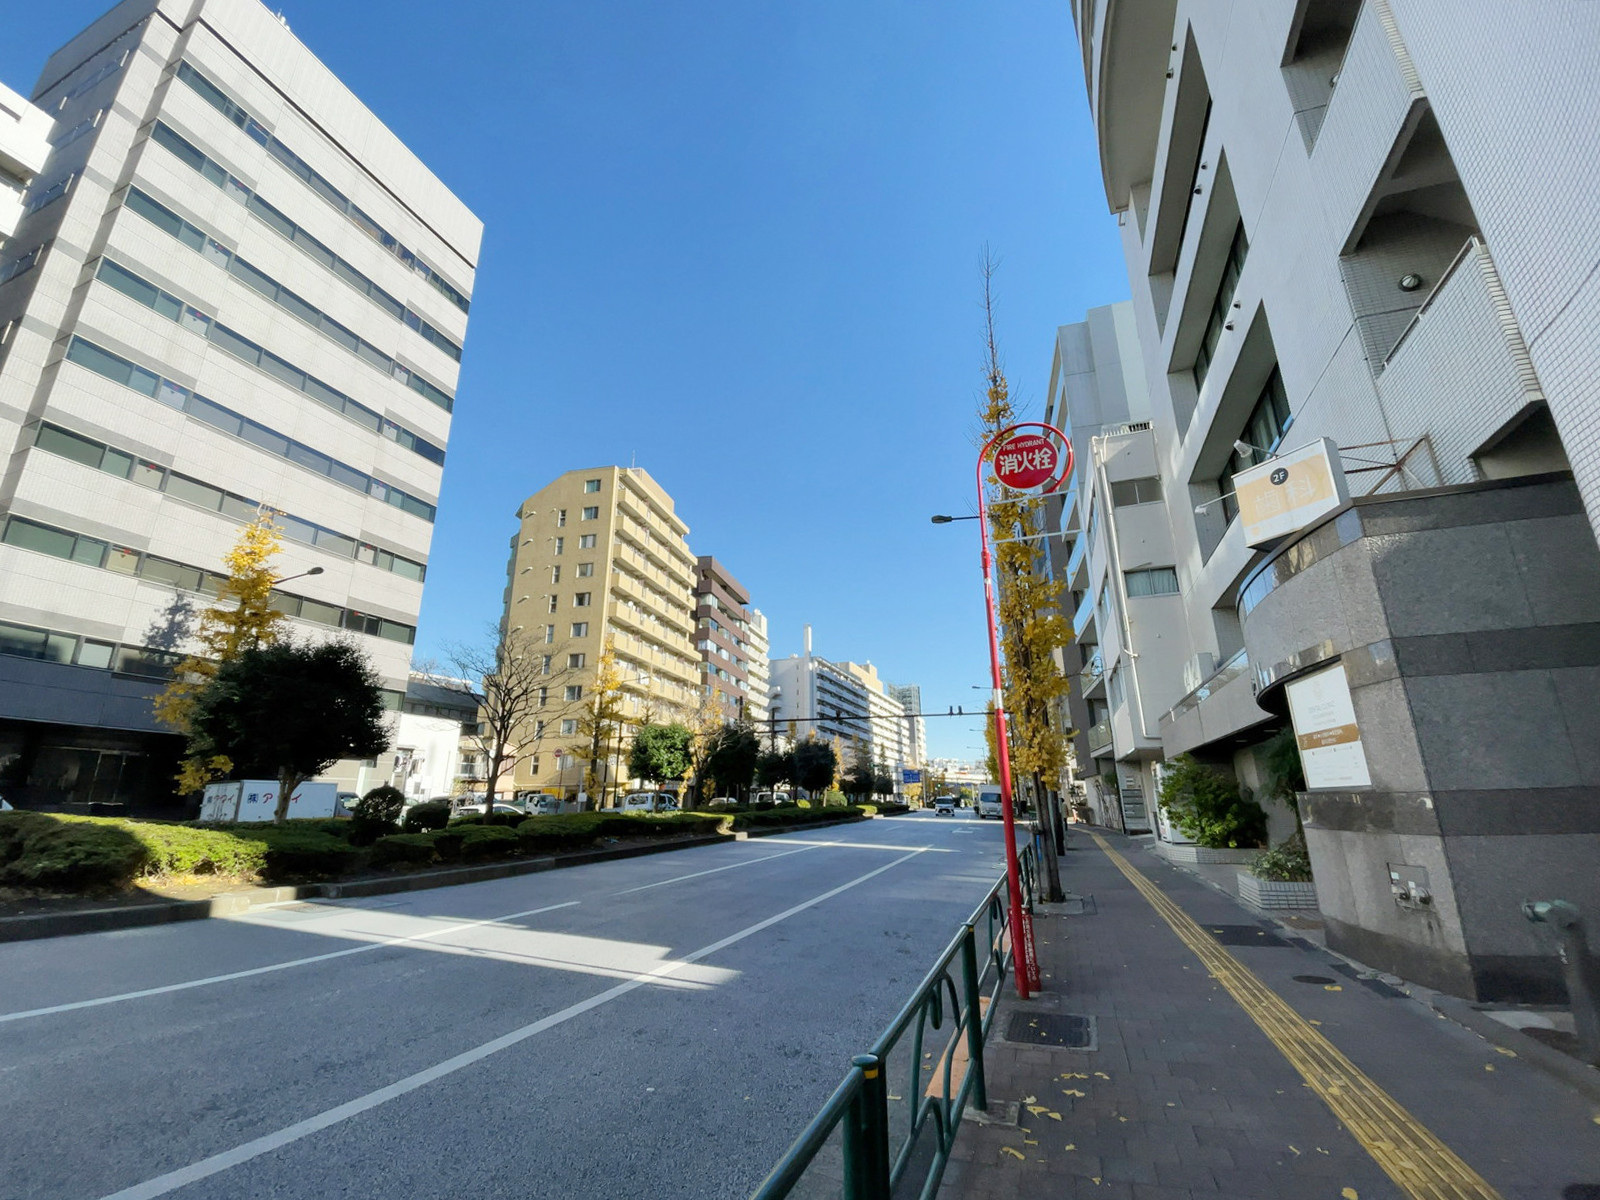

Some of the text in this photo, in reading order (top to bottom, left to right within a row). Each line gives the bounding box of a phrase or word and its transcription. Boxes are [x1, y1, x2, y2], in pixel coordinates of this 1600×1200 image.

[1003, 439, 1045, 451] FIRE HYDRANT
[999, 447, 1053, 476] 消火栓
[1273, 471, 1285, 482] 2F
[1255, 475, 1315, 516] 歯科
